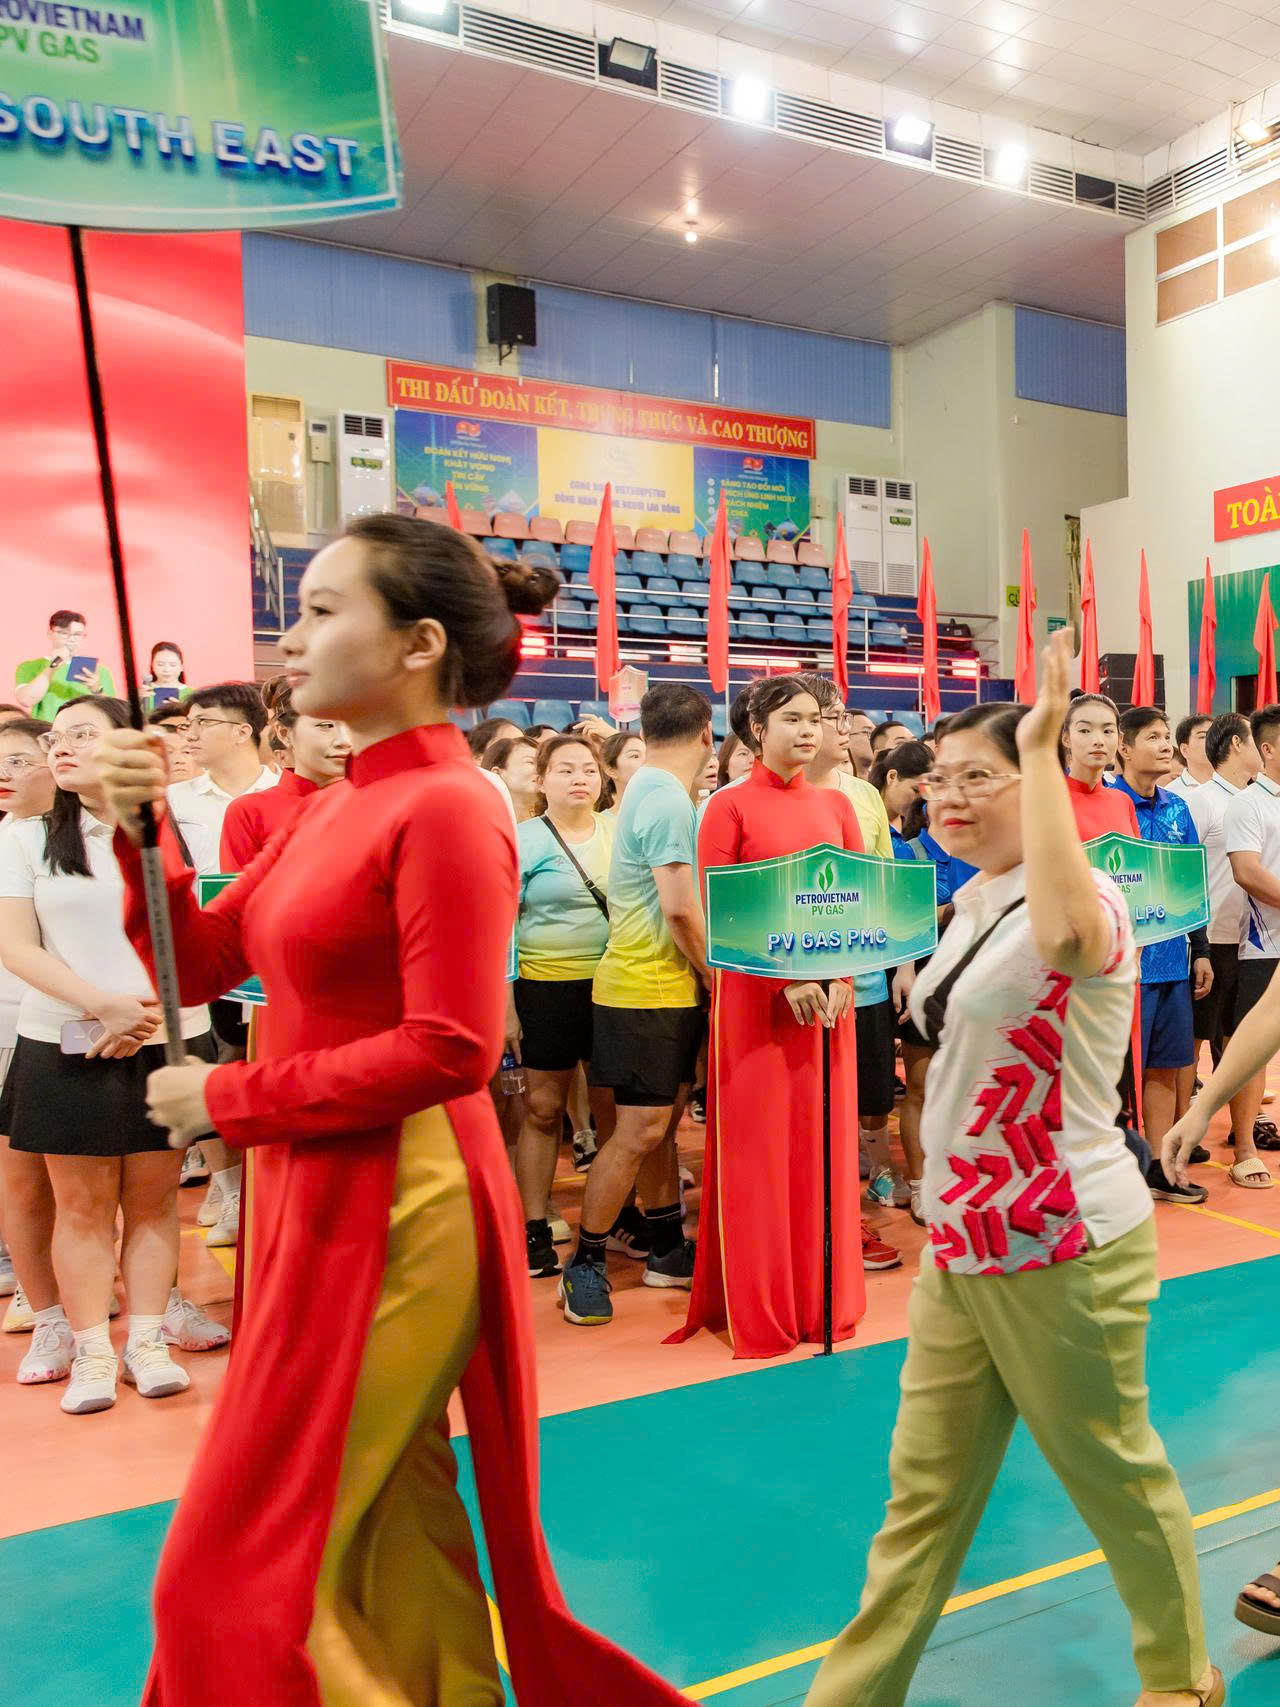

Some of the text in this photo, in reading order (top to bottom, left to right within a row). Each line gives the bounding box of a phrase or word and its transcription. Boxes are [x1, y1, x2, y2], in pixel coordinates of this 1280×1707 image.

[0, 0, 145, 41] OVIETNAM
[39, 31, 100, 63] GAS
[212, 121, 360, 178] EAST
[396, 376, 431, 401] THI
[435, 376, 475, 406] ĐẤU
[479, 386, 530, 413] ĐOÀN
[687, 412, 708, 436] VÀ
[712, 418, 744, 441] CAO
[746, 422, 808, 450] THƯỢNG
[1109, 873, 1143, 884] VIETNAM
[1117, 884, 1131, 894] AS
[795, 892, 859, 905] PETROVIETNAM
[811, 904, 844, 916] PV GAS
[1135, 904, 1166, 922] LPG
[767, 927, 888, 951] PV GAS PMC
